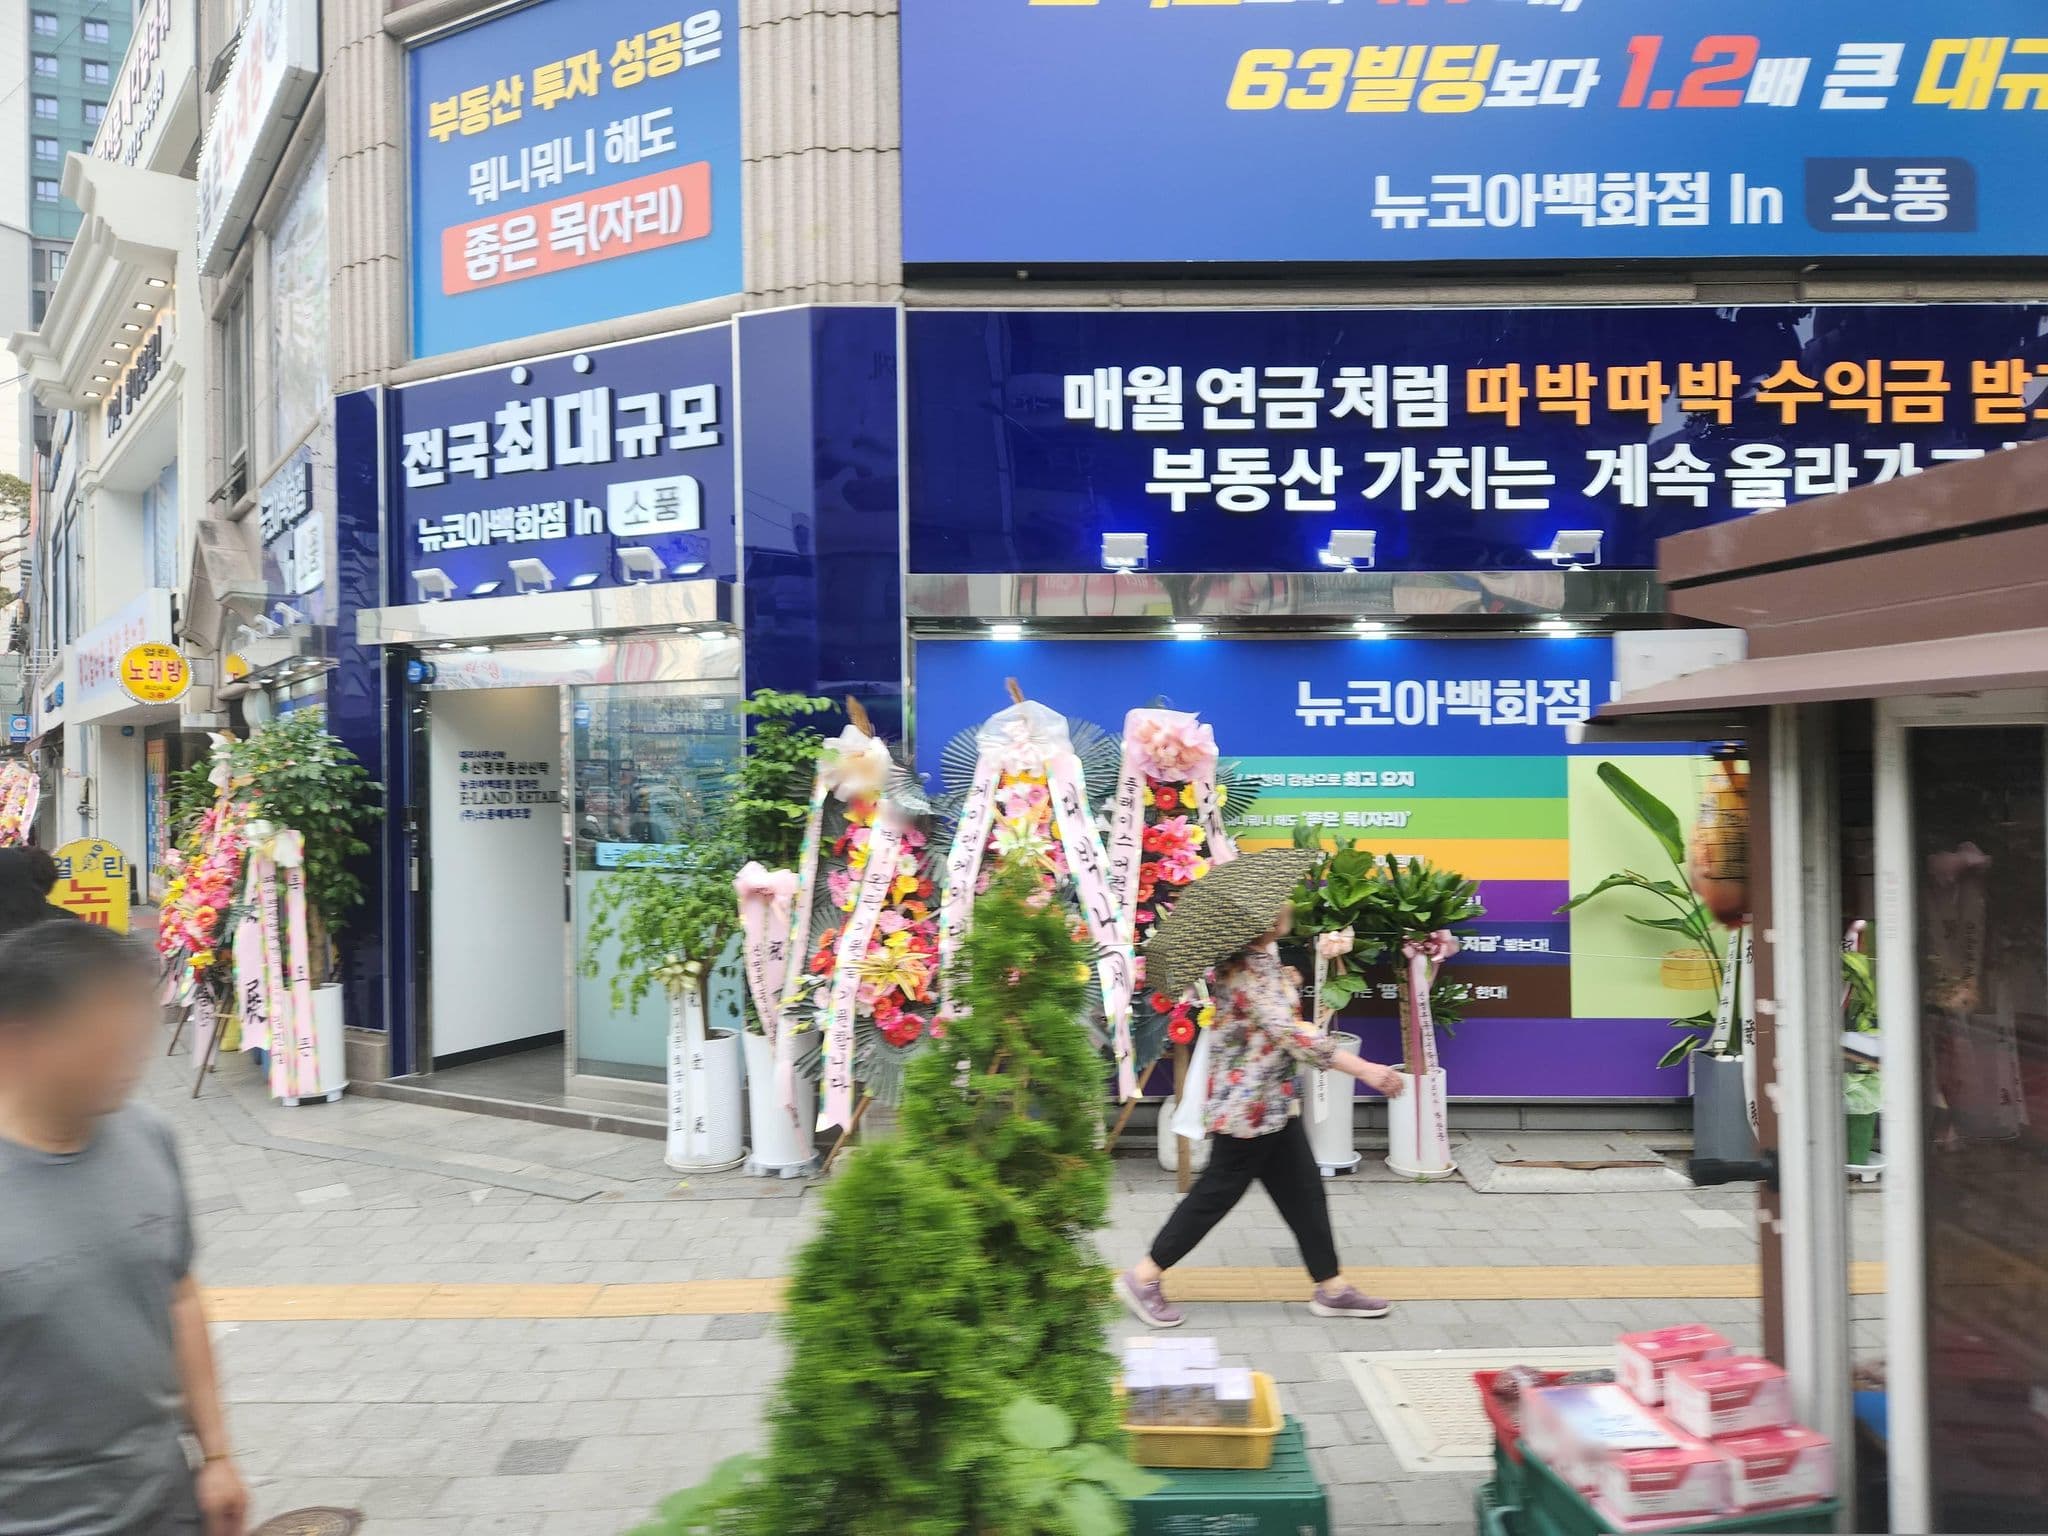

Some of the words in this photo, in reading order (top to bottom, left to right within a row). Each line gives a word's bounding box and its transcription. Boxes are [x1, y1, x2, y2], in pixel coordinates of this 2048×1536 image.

[428, 75, 525, 143] 부동산
[532, 49, 602, 110] 투자
[609, 9, 723, 89] 성공은
[1226, 44, 1600, 113] 63빌딩보다
[1618, 34, 1812, 110] 1.2배
[1819, 42, 1906, 110] 큰
[468, 128, 596, 206] 뭐니뭐니
[603, 106, 677, 165] 해도
[463, 215, 538, 281] 좋은
[549, 184, 684, 256] 목(자리)
[1370, 171, 1711, 230] 뉴코아백화점
[1730, 173, 1784, 225] In
[1831, 168, 1951, 222] 소풍
[1063, 365, 1185, 431] 매월
[1196, 364, 1449, 431] 연금처럼
[1466, 361, 1742, 426] 따박따박
[1755, 358, 1952, 425] 수익금
[1145, 446, 1344, 513] 부동산
[1361, 446, 1557, 511] 가치는
[1582, 443, 1716, 508] 계속
[417, 499, 568, 551] 뉴코아백화점
[573, 498, 604, 537] In
[623, 486, 680, 526] 소풍
[128, 659, 182, 683] 노래방
[1295, 679, 1593, 727] 뉴코아백화점
[1343, 770, 1378, 788] 최고
[1380, 770, 1415, 788] 요지
